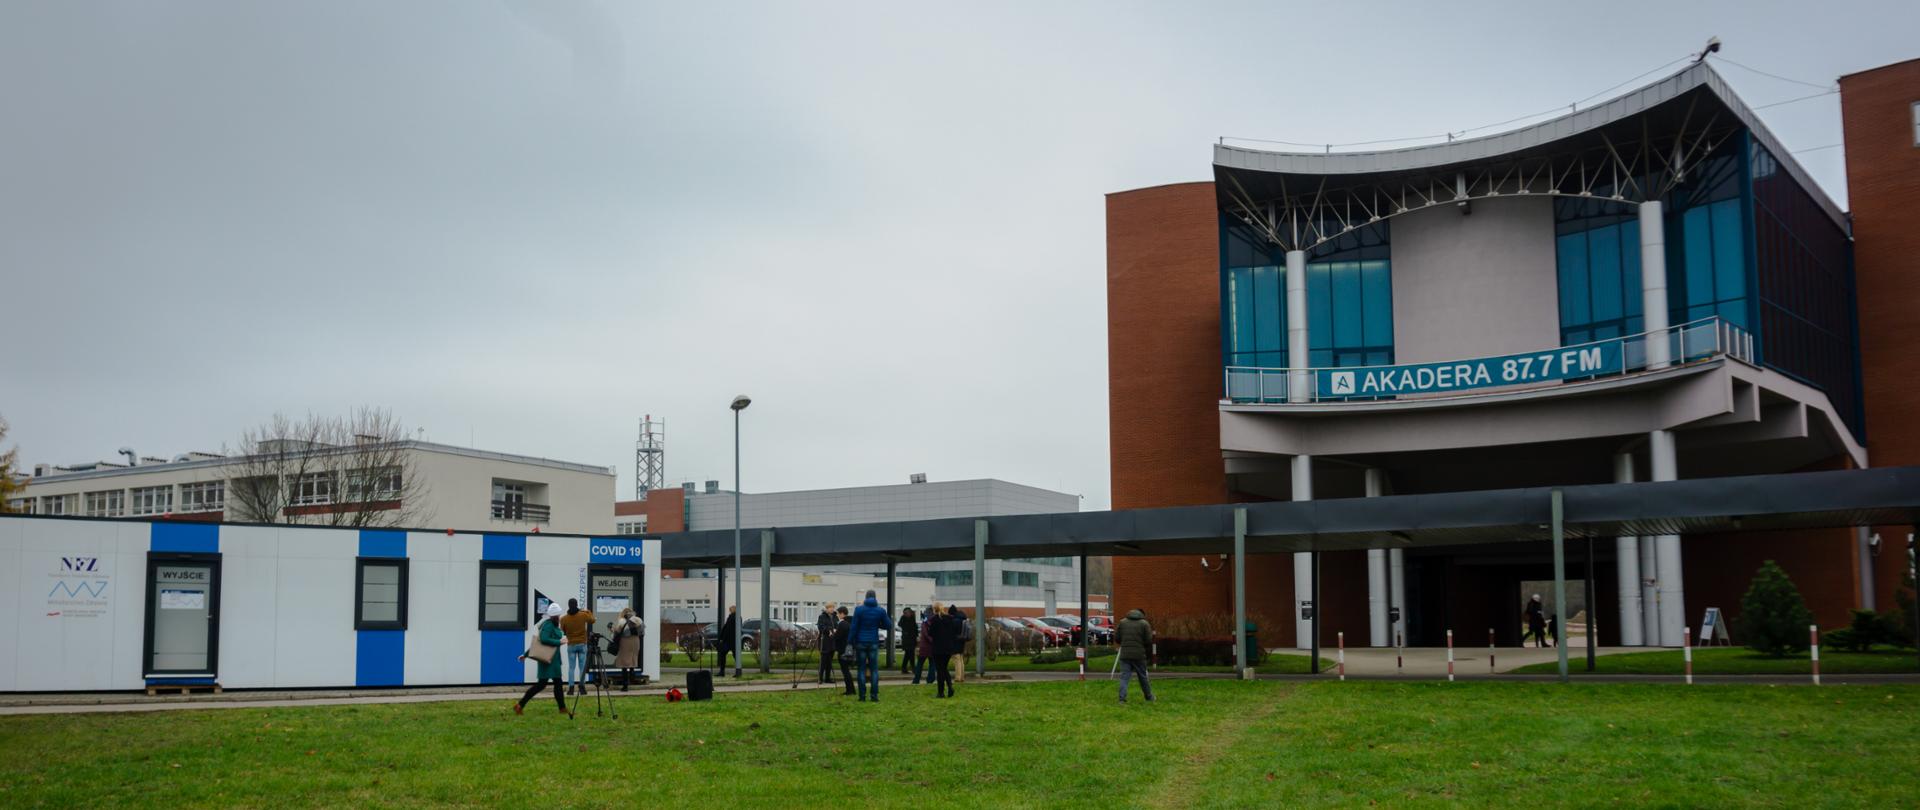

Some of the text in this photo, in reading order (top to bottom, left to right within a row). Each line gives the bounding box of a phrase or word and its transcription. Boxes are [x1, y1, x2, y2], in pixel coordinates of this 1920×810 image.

[1362, 362, 1492, 393] AKADERA
[1502, 354, 1555, 381] 87.7
[1561, 347, 1602, 374] FM
[591, 545, 641, 557] COVID 19
[60, 557, 98, 572] NFZ
[162, 571, 205, 580] WYJŚCIE
[598, 579, 629, 587] WEJŚCIE
